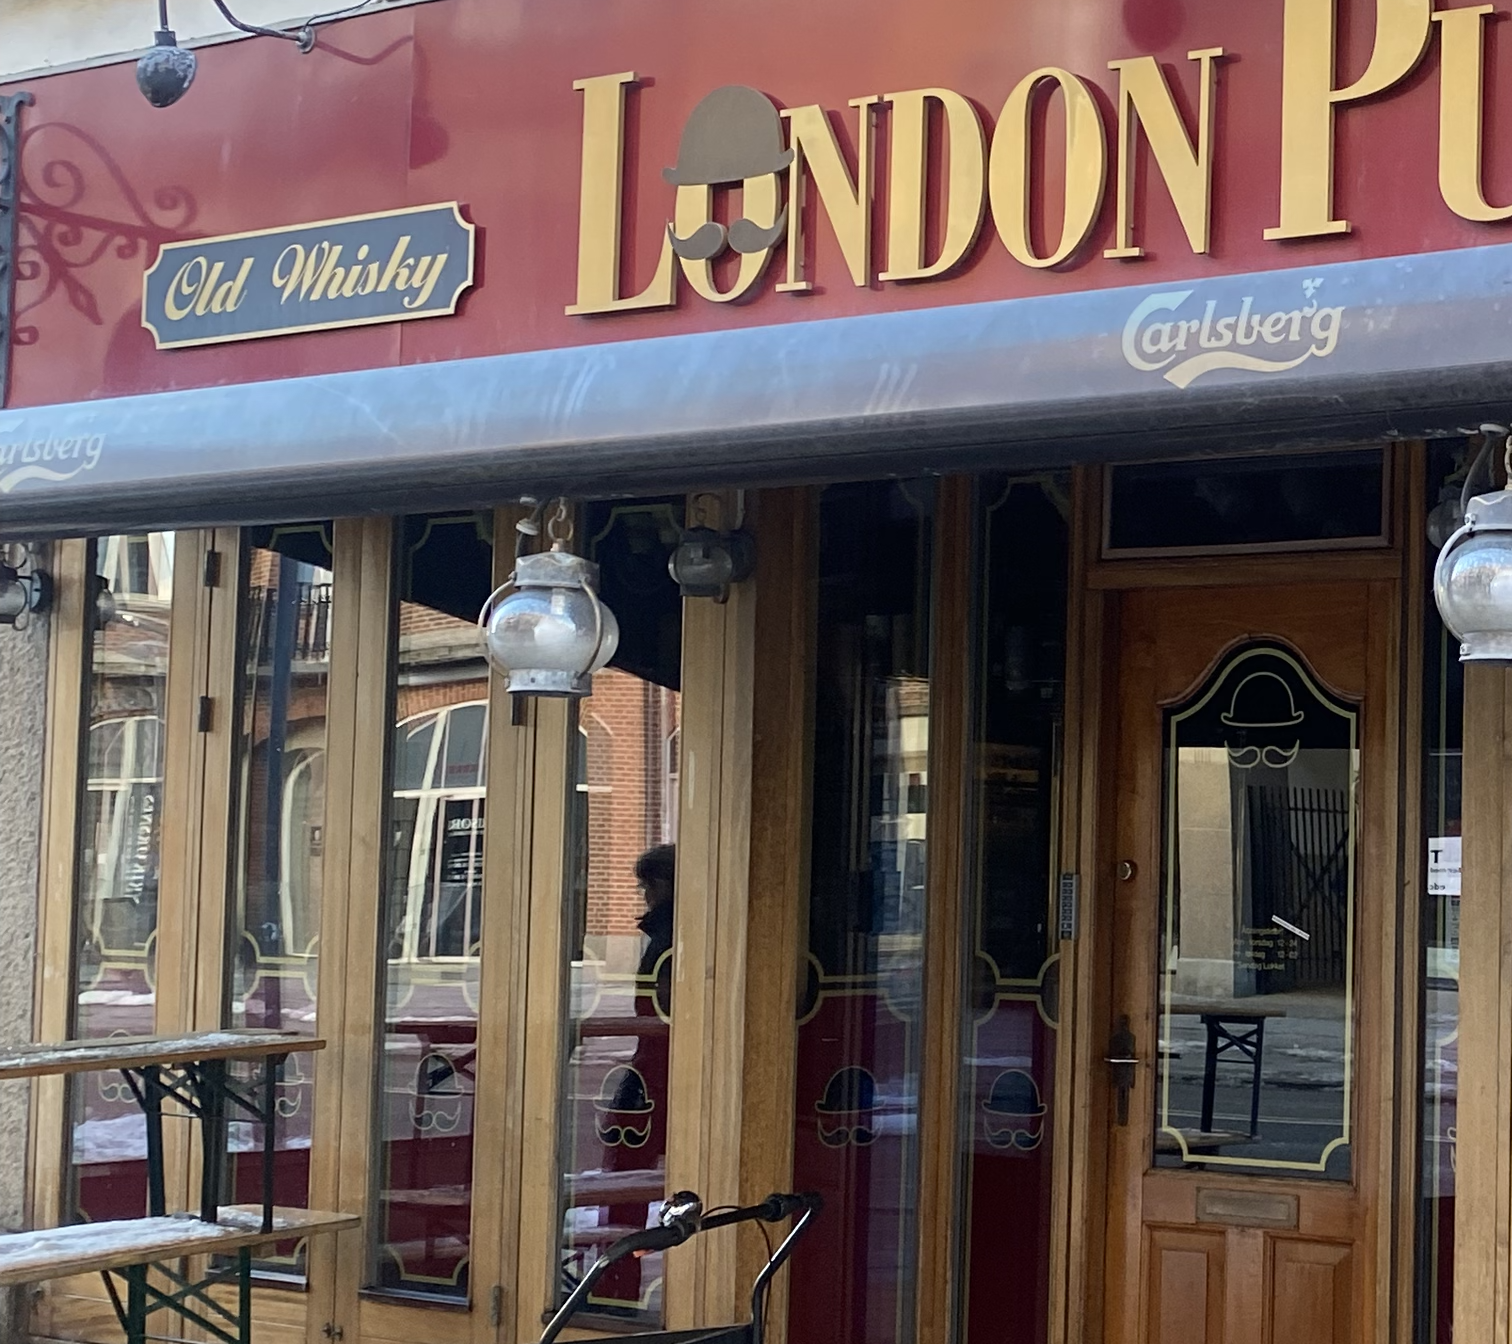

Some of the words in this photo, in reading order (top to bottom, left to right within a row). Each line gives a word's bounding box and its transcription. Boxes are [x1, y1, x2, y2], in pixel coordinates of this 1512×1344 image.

[164, 255, 255, 321] Old
[271, 235, 449, 309] Whisky
[1122, 282, 1345, 376] Carlsberg
